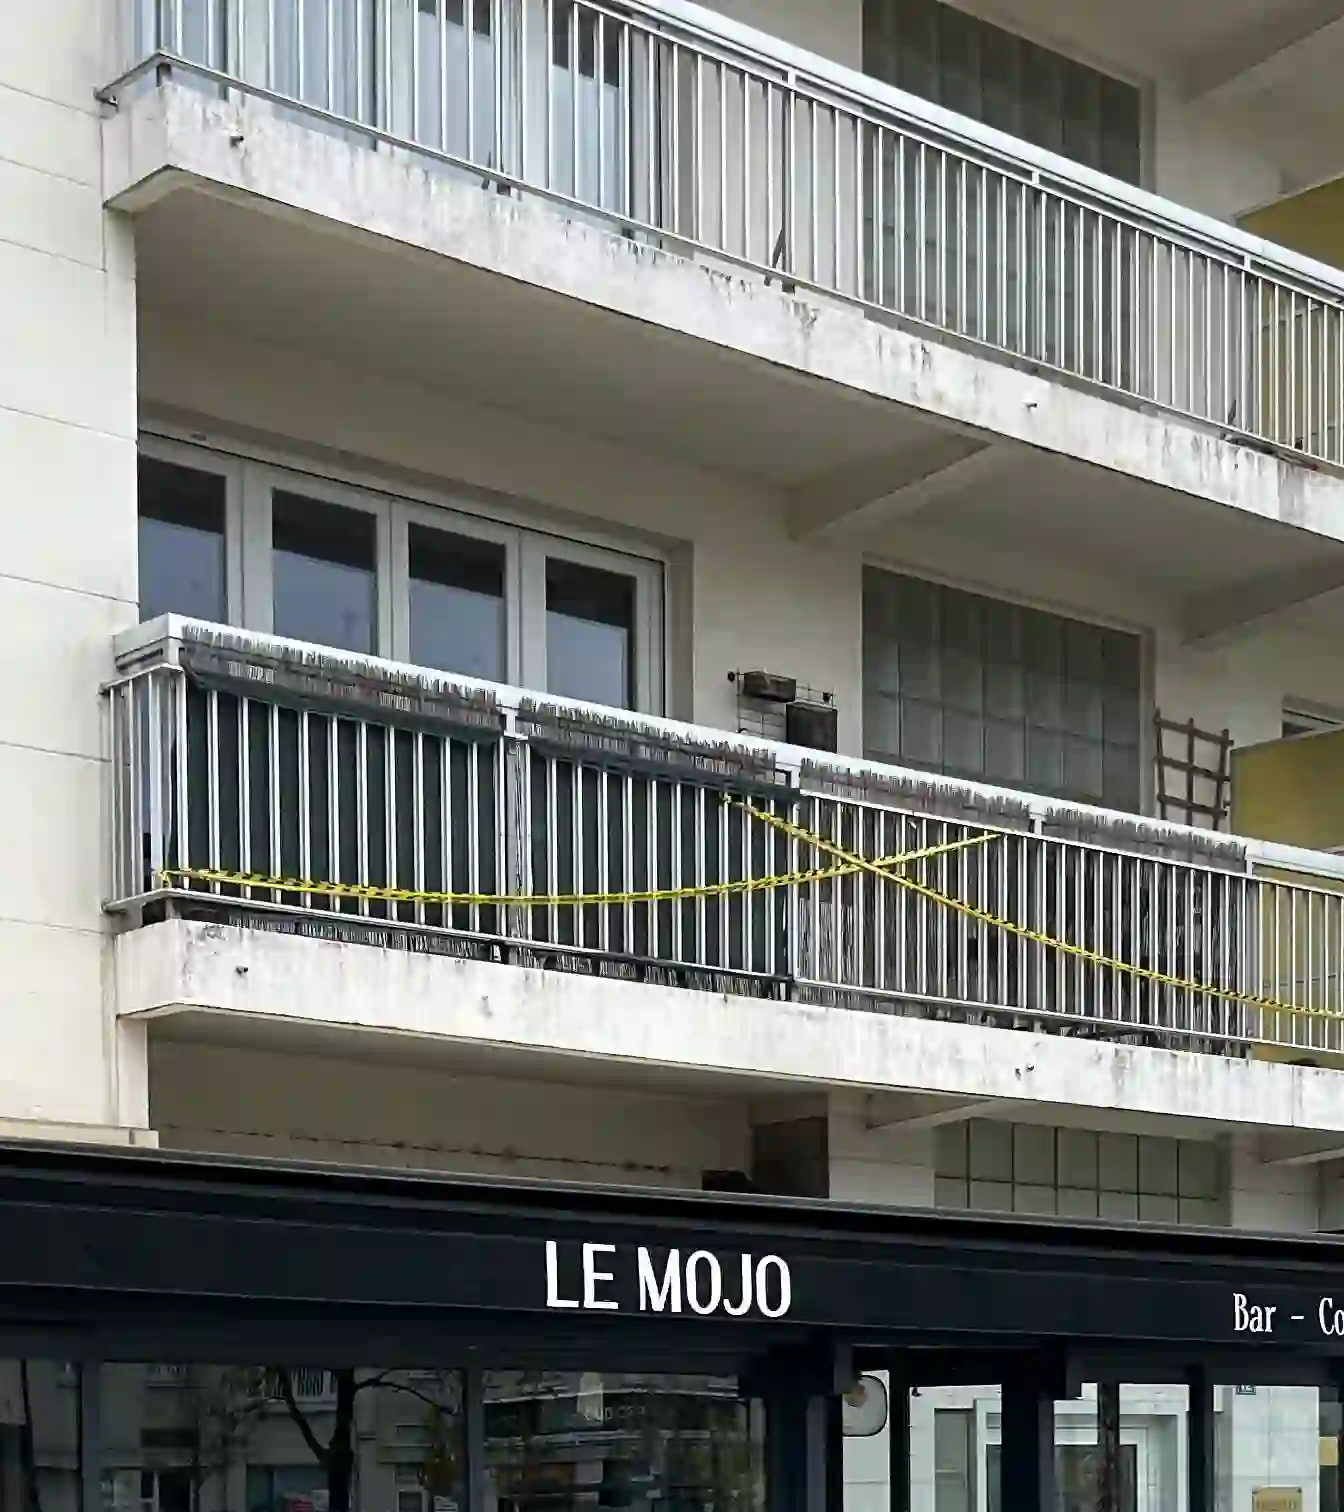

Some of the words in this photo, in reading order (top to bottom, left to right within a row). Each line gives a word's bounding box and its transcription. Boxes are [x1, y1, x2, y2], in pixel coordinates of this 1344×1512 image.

[545, 1240, 619, 1311] LE
[637, 1245, 792, 1319] MOJO
[1232, 1292, 1277, 1334] Bar
